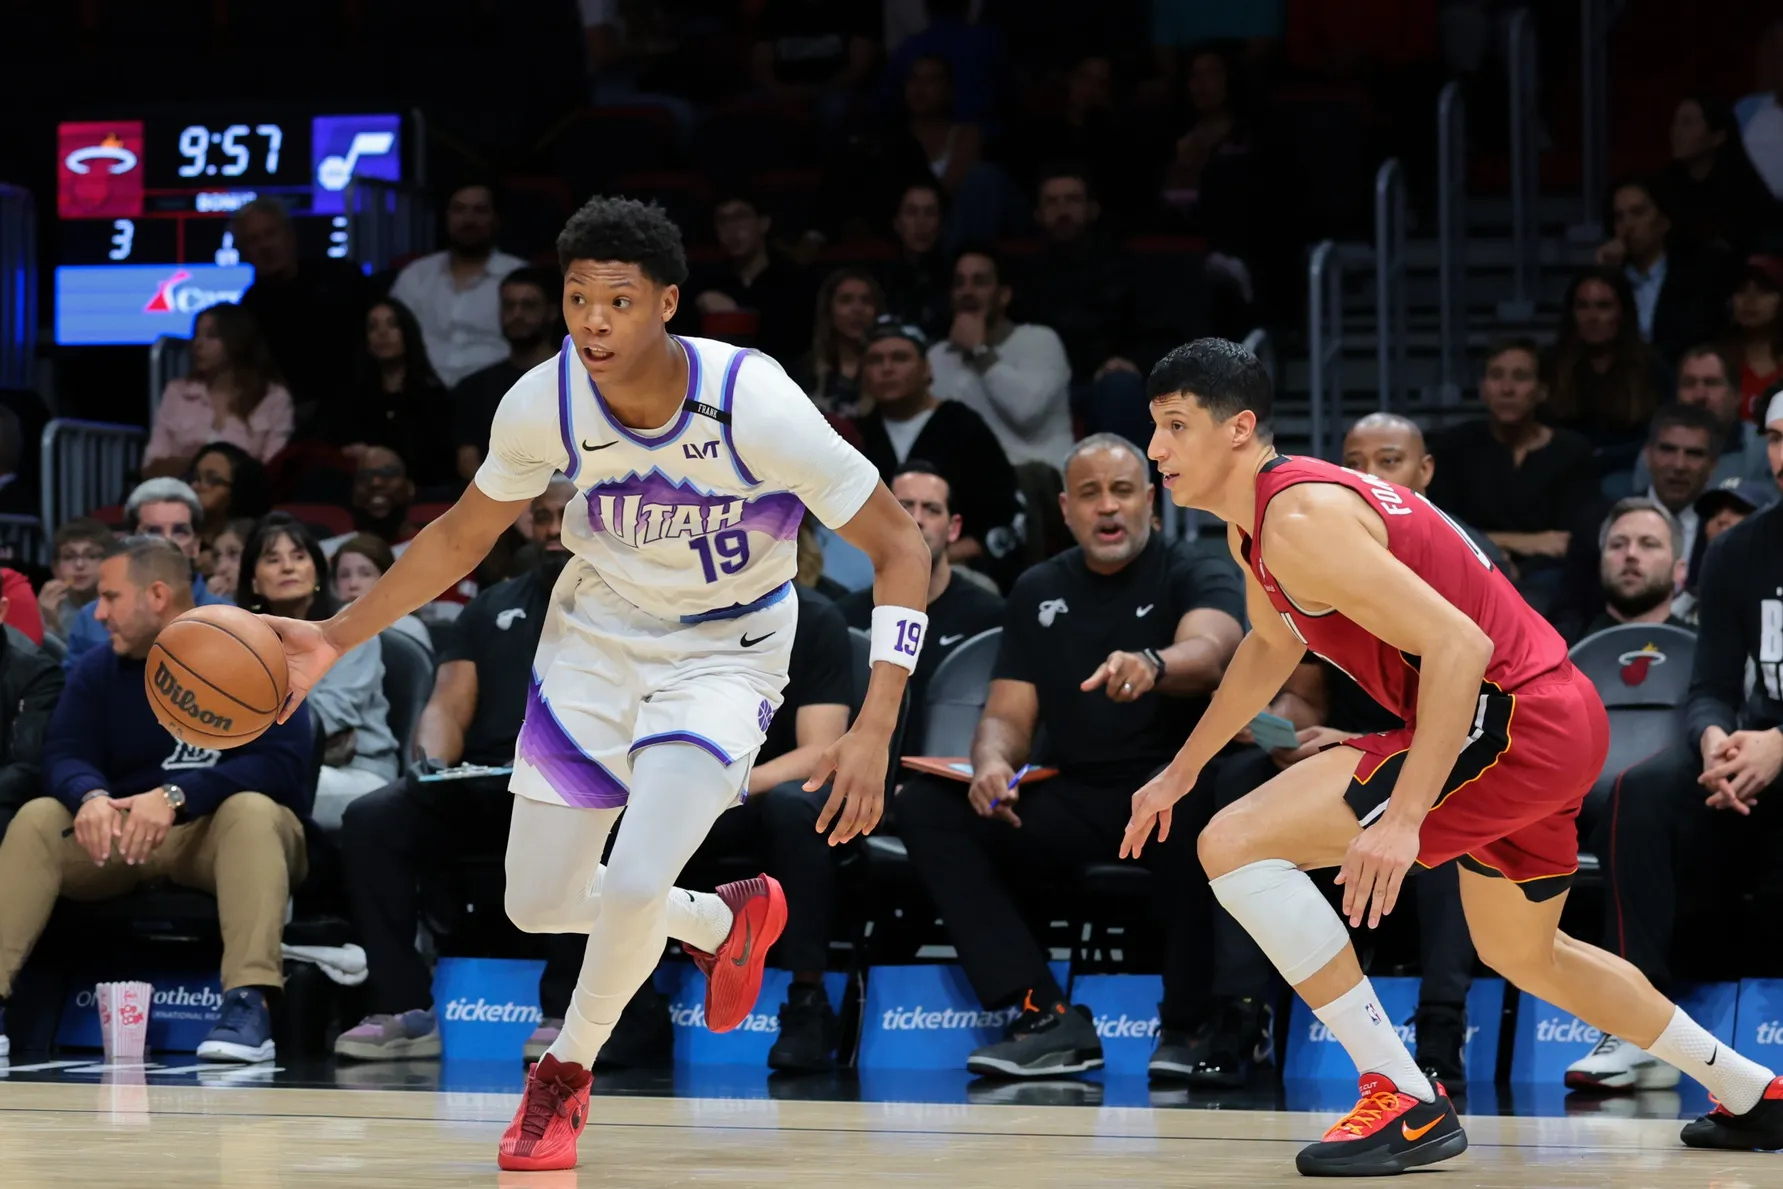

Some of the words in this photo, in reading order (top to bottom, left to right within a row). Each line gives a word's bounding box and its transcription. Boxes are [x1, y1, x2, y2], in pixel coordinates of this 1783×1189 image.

[178, 125, 283, 178] 9:57
[109, 219, 134, 260] 3
[697, 403, 719, 419] FRANK
[682, 440, 721, 460] LVT
[598, 494, 748, 549] UTAH
[688, 529, 750, 584] 19
[893, 619, 922, 657] 19
[154, 660, 233, 732] Wilson
